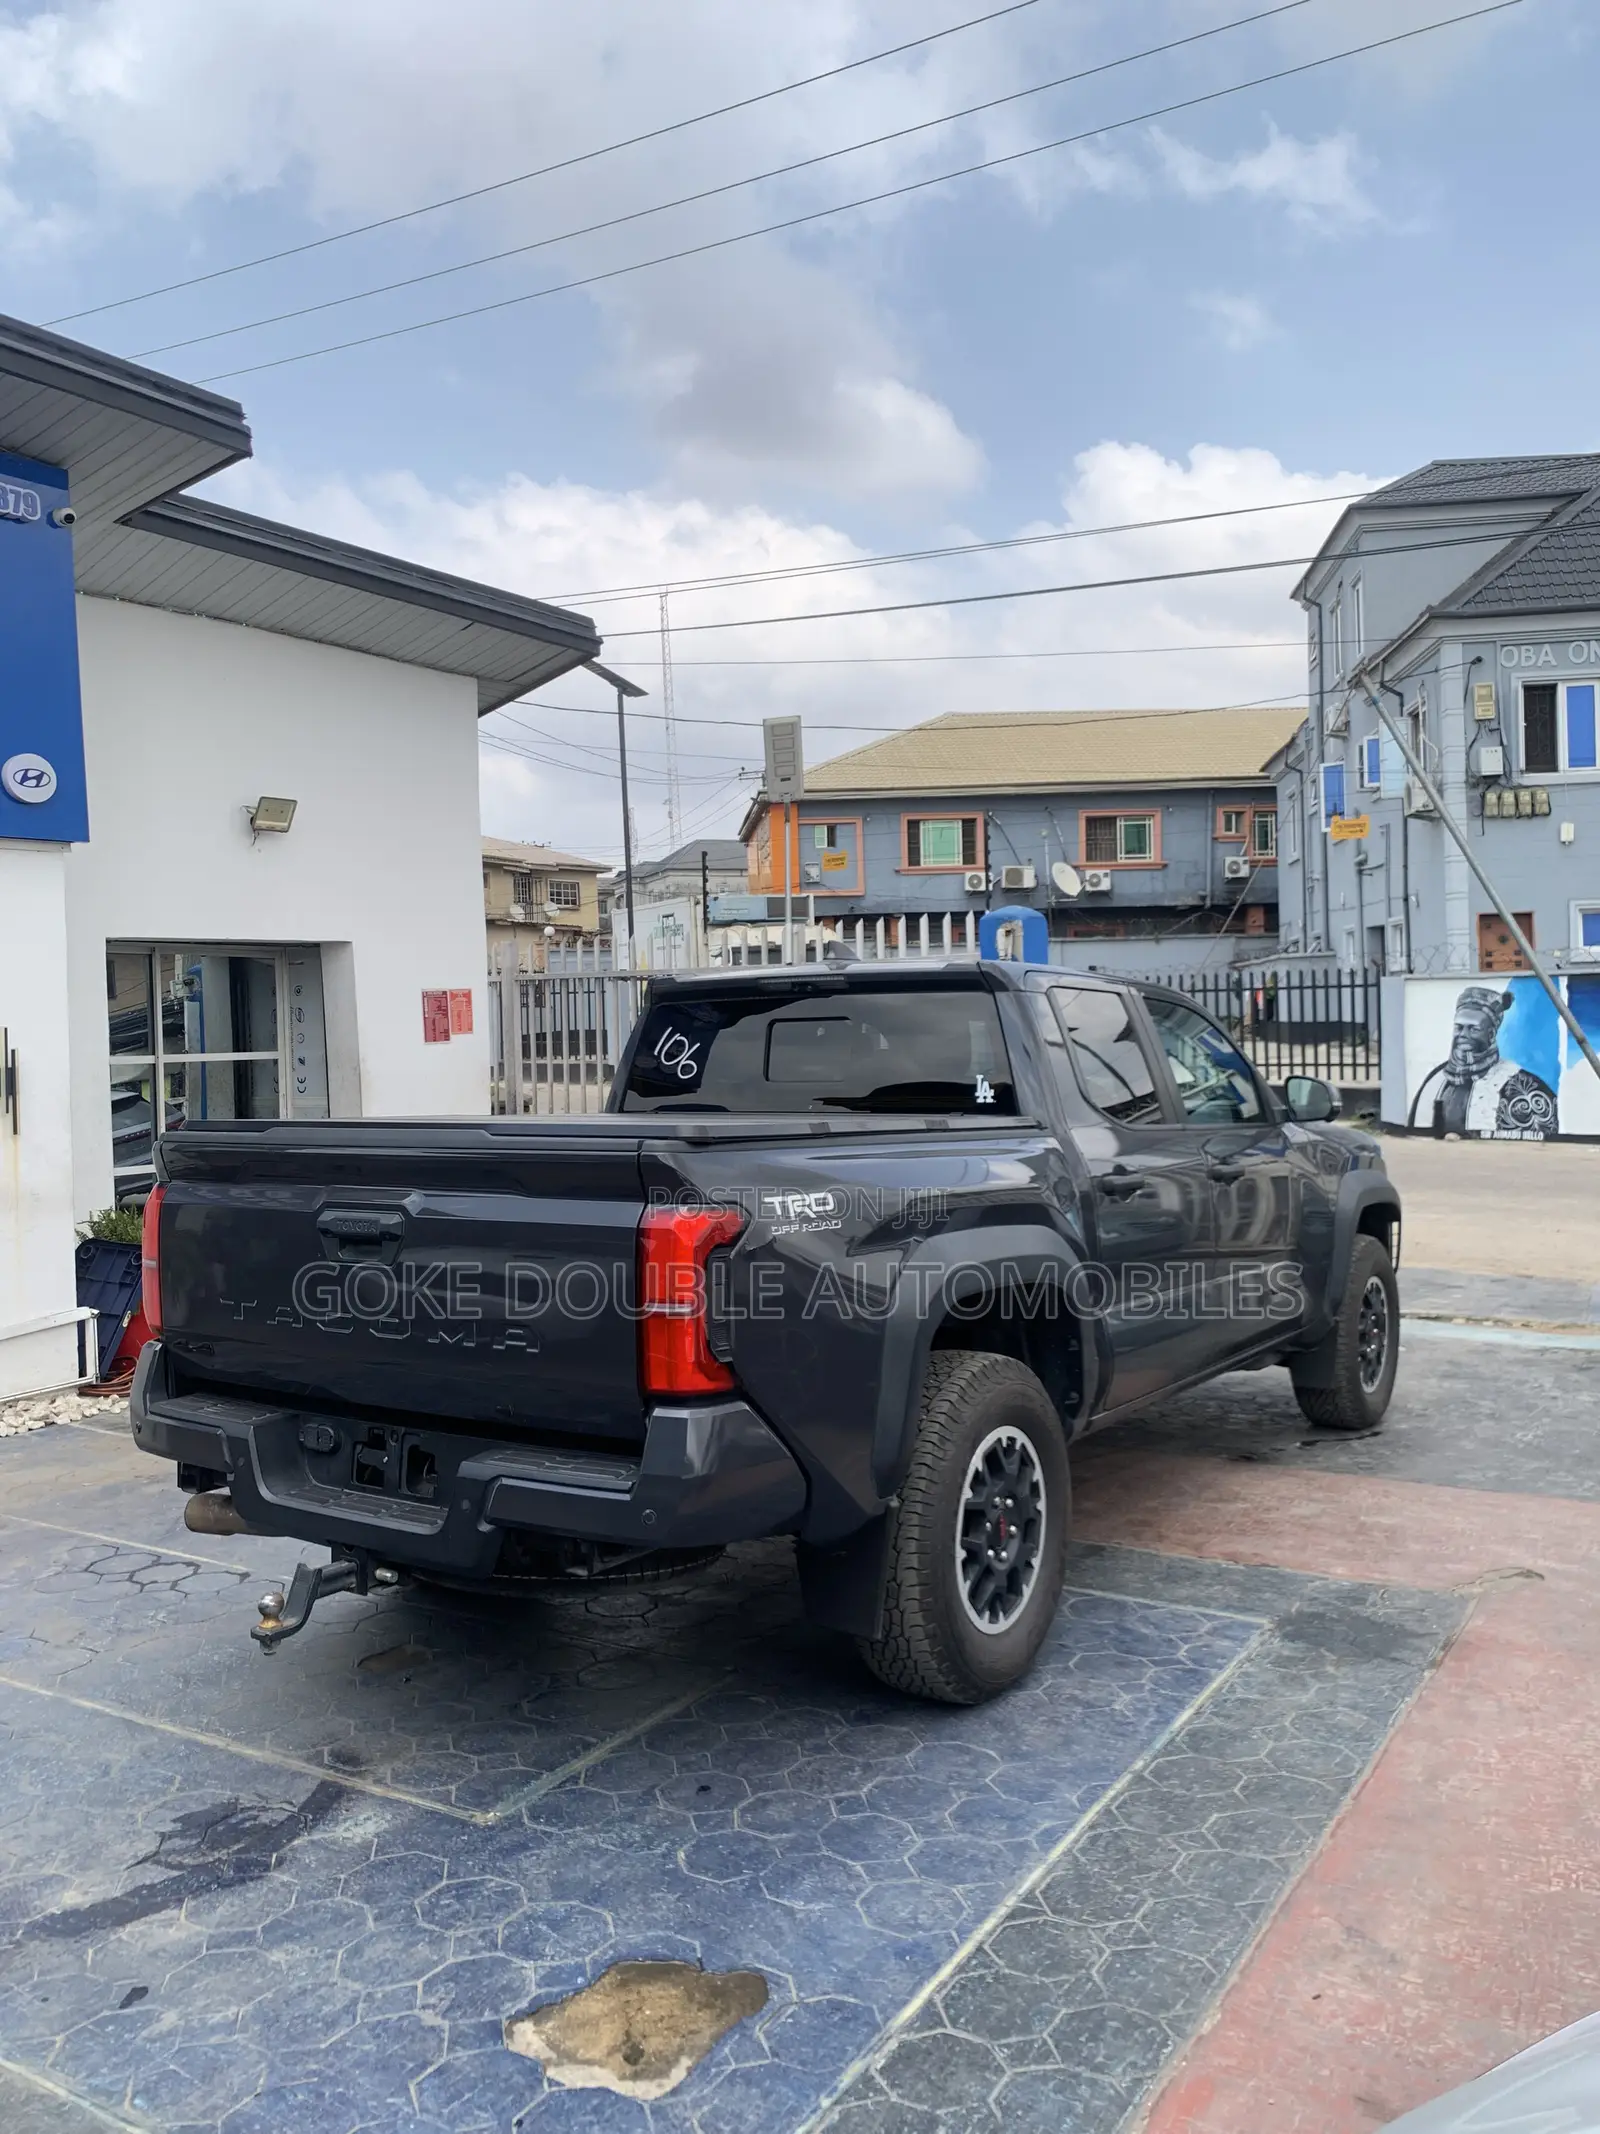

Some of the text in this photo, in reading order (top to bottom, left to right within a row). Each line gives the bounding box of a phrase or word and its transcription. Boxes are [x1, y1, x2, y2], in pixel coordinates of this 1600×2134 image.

[1501, 644, 1558, 668] OBA
[654, 1026, 701, 1079] 106
[764, 1192, 835, 1220] TRD
[336, 1219, 378, 1232] TOYOTA
[220, 1297, 541, 1353] TACOMA
